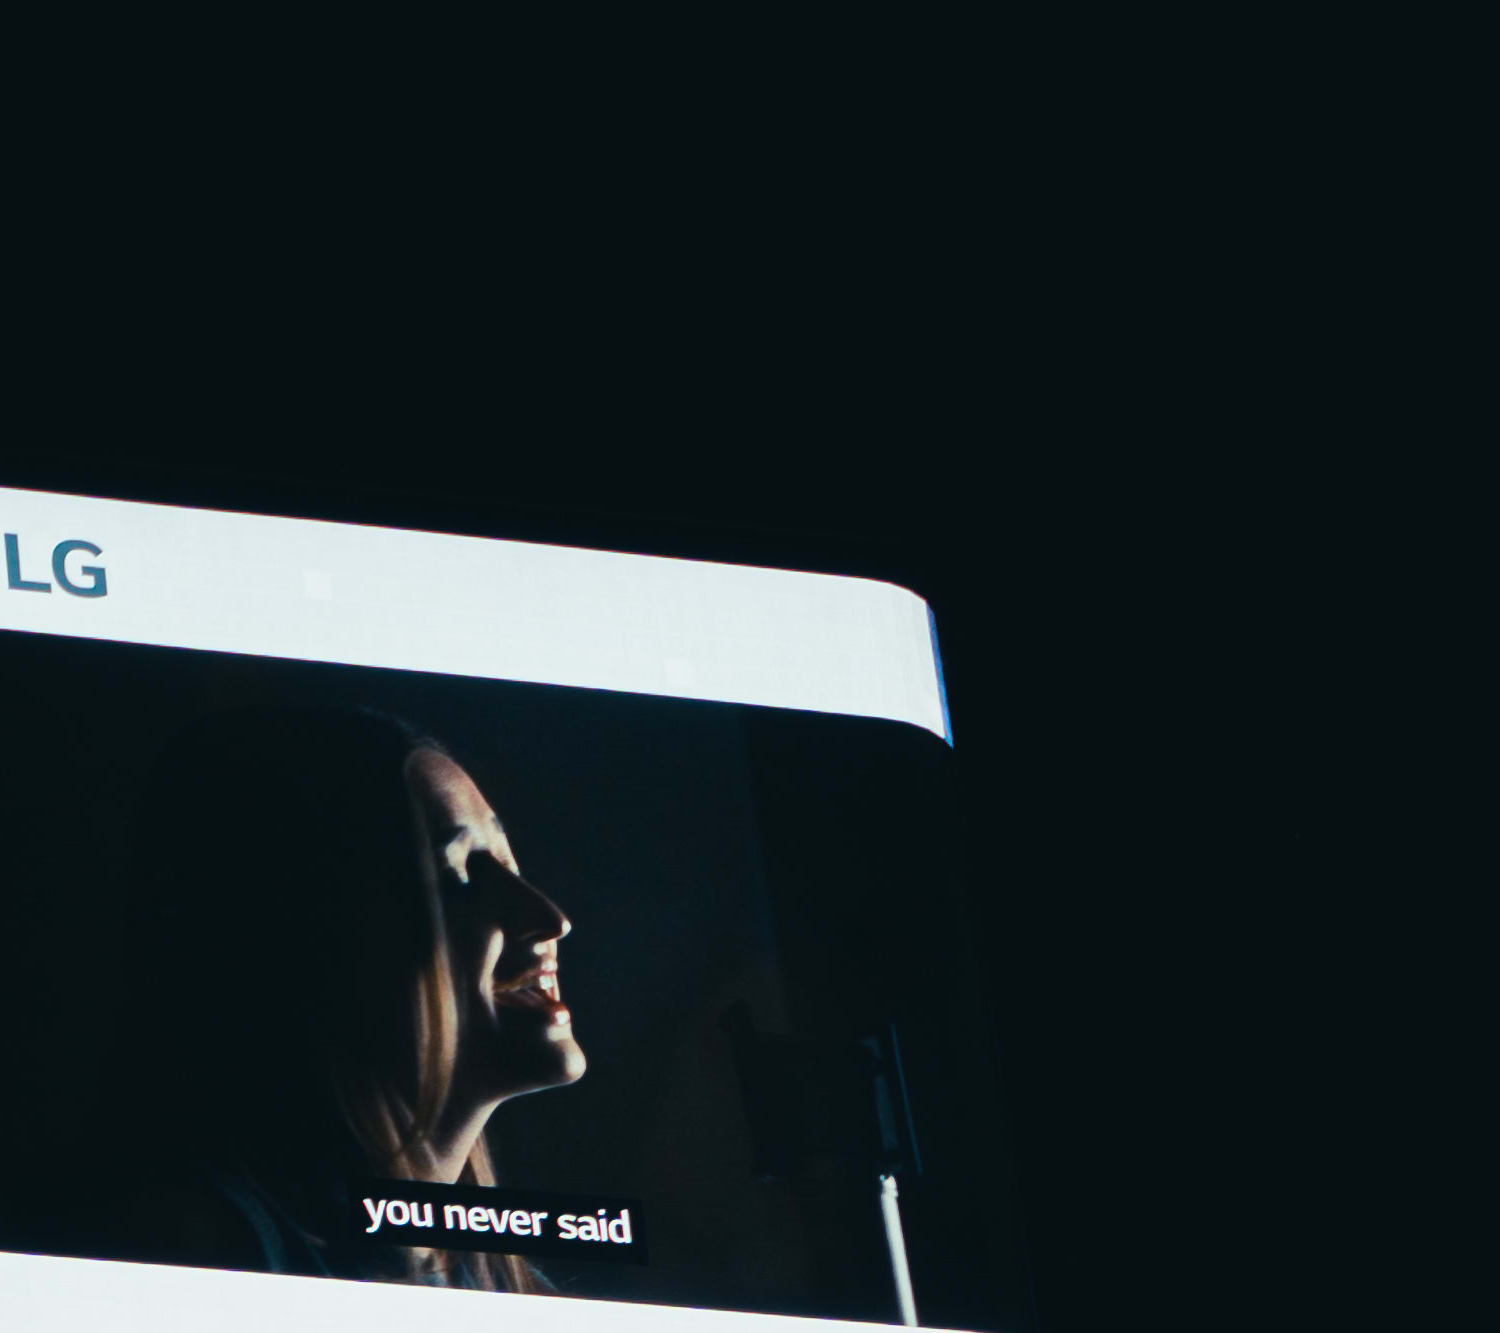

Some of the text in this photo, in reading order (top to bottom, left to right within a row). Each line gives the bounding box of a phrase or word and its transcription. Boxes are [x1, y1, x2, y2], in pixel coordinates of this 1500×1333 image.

[4, 533, 108, 598] LG
[362, 1193, 633, 1248] you never said
